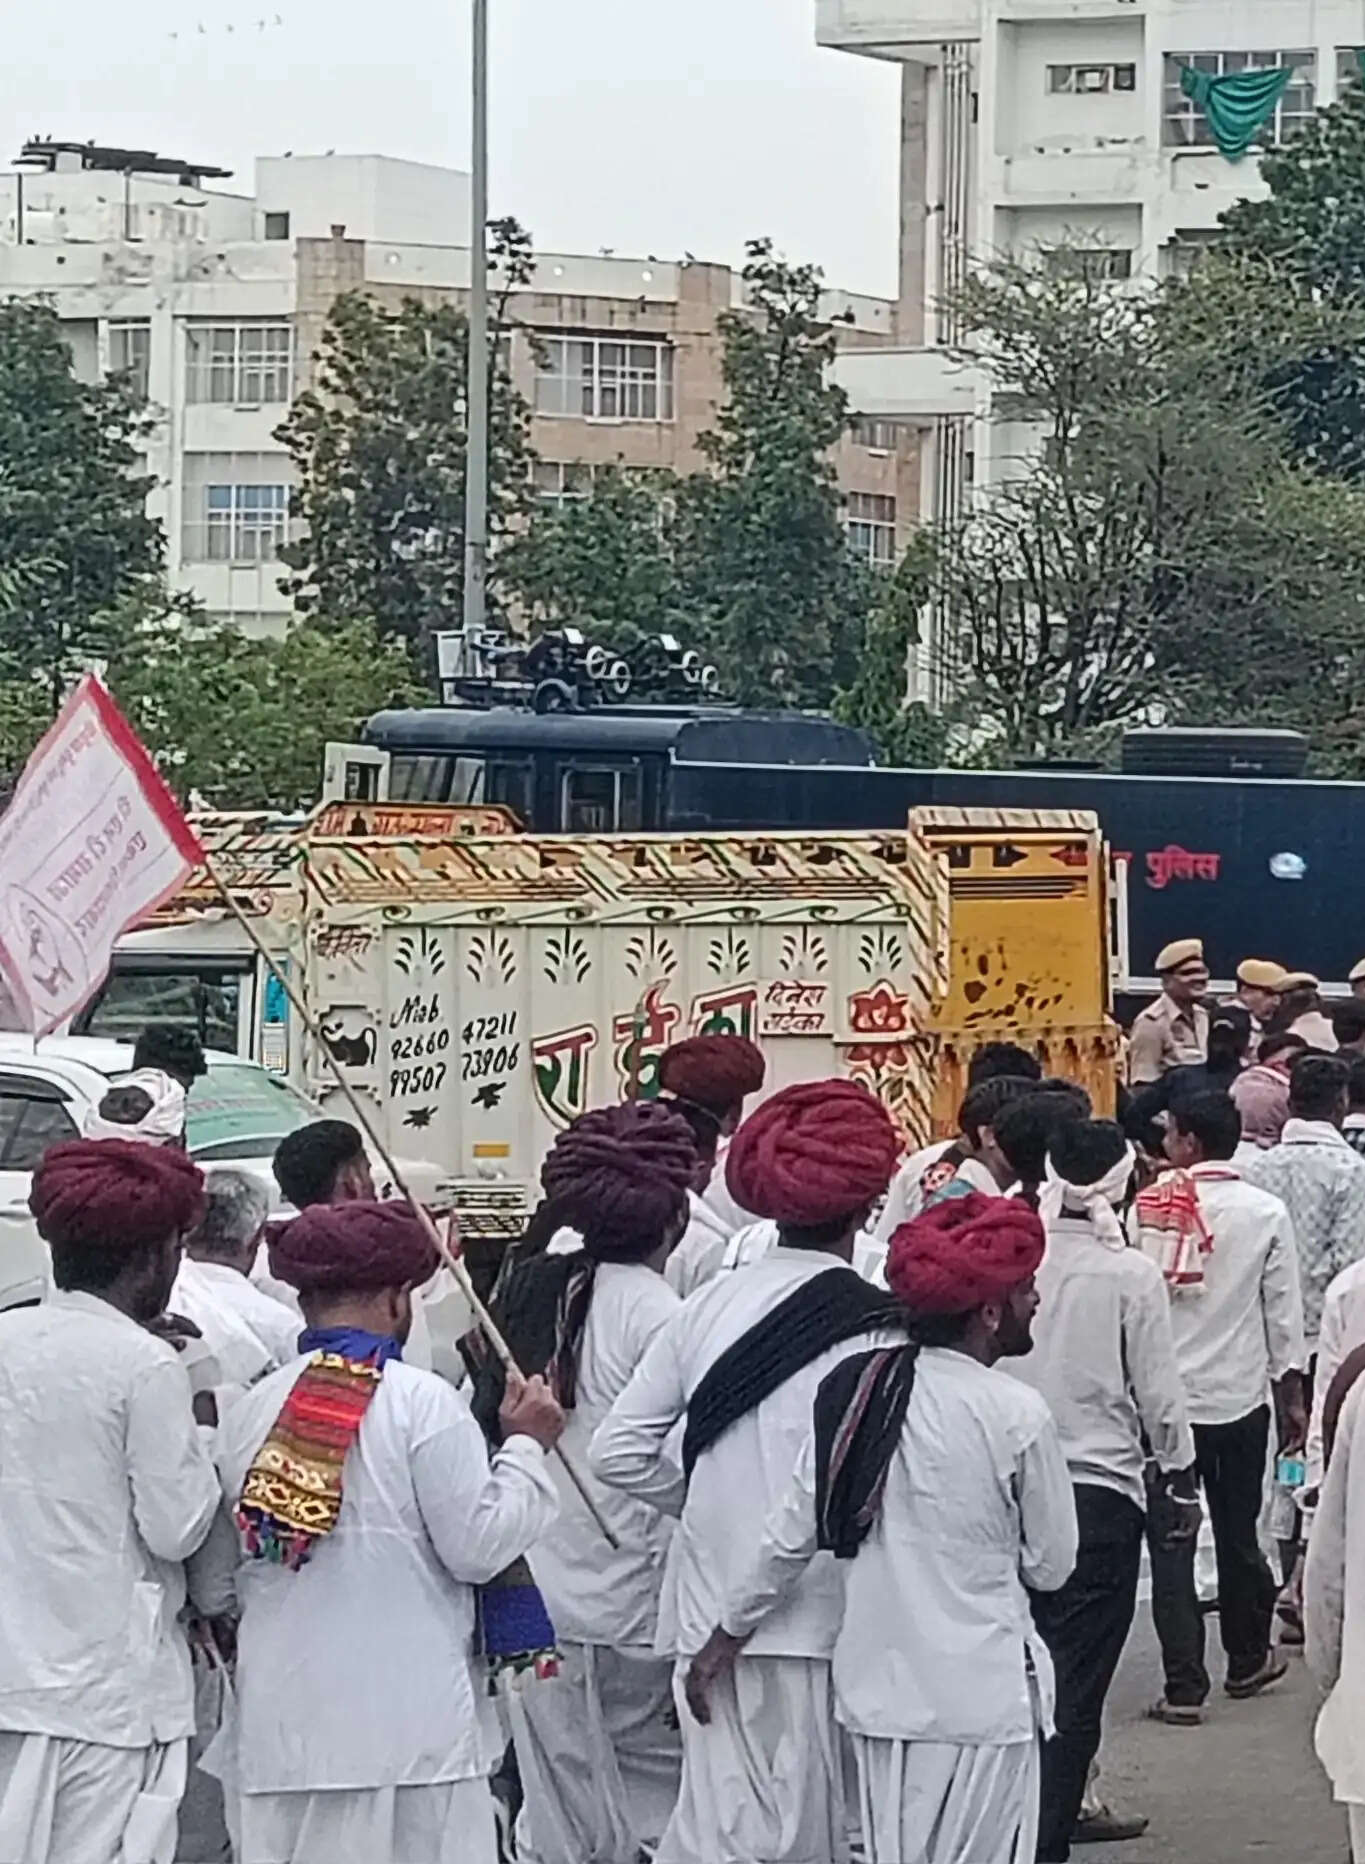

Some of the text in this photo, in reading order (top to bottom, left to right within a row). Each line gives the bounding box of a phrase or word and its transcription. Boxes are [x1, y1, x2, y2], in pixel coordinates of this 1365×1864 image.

[1144, 844, 1220, 889] पुलिस
[391, 1011, 517, 1061] 92660 47211
[390, 1062, 447, 1098] 99507
